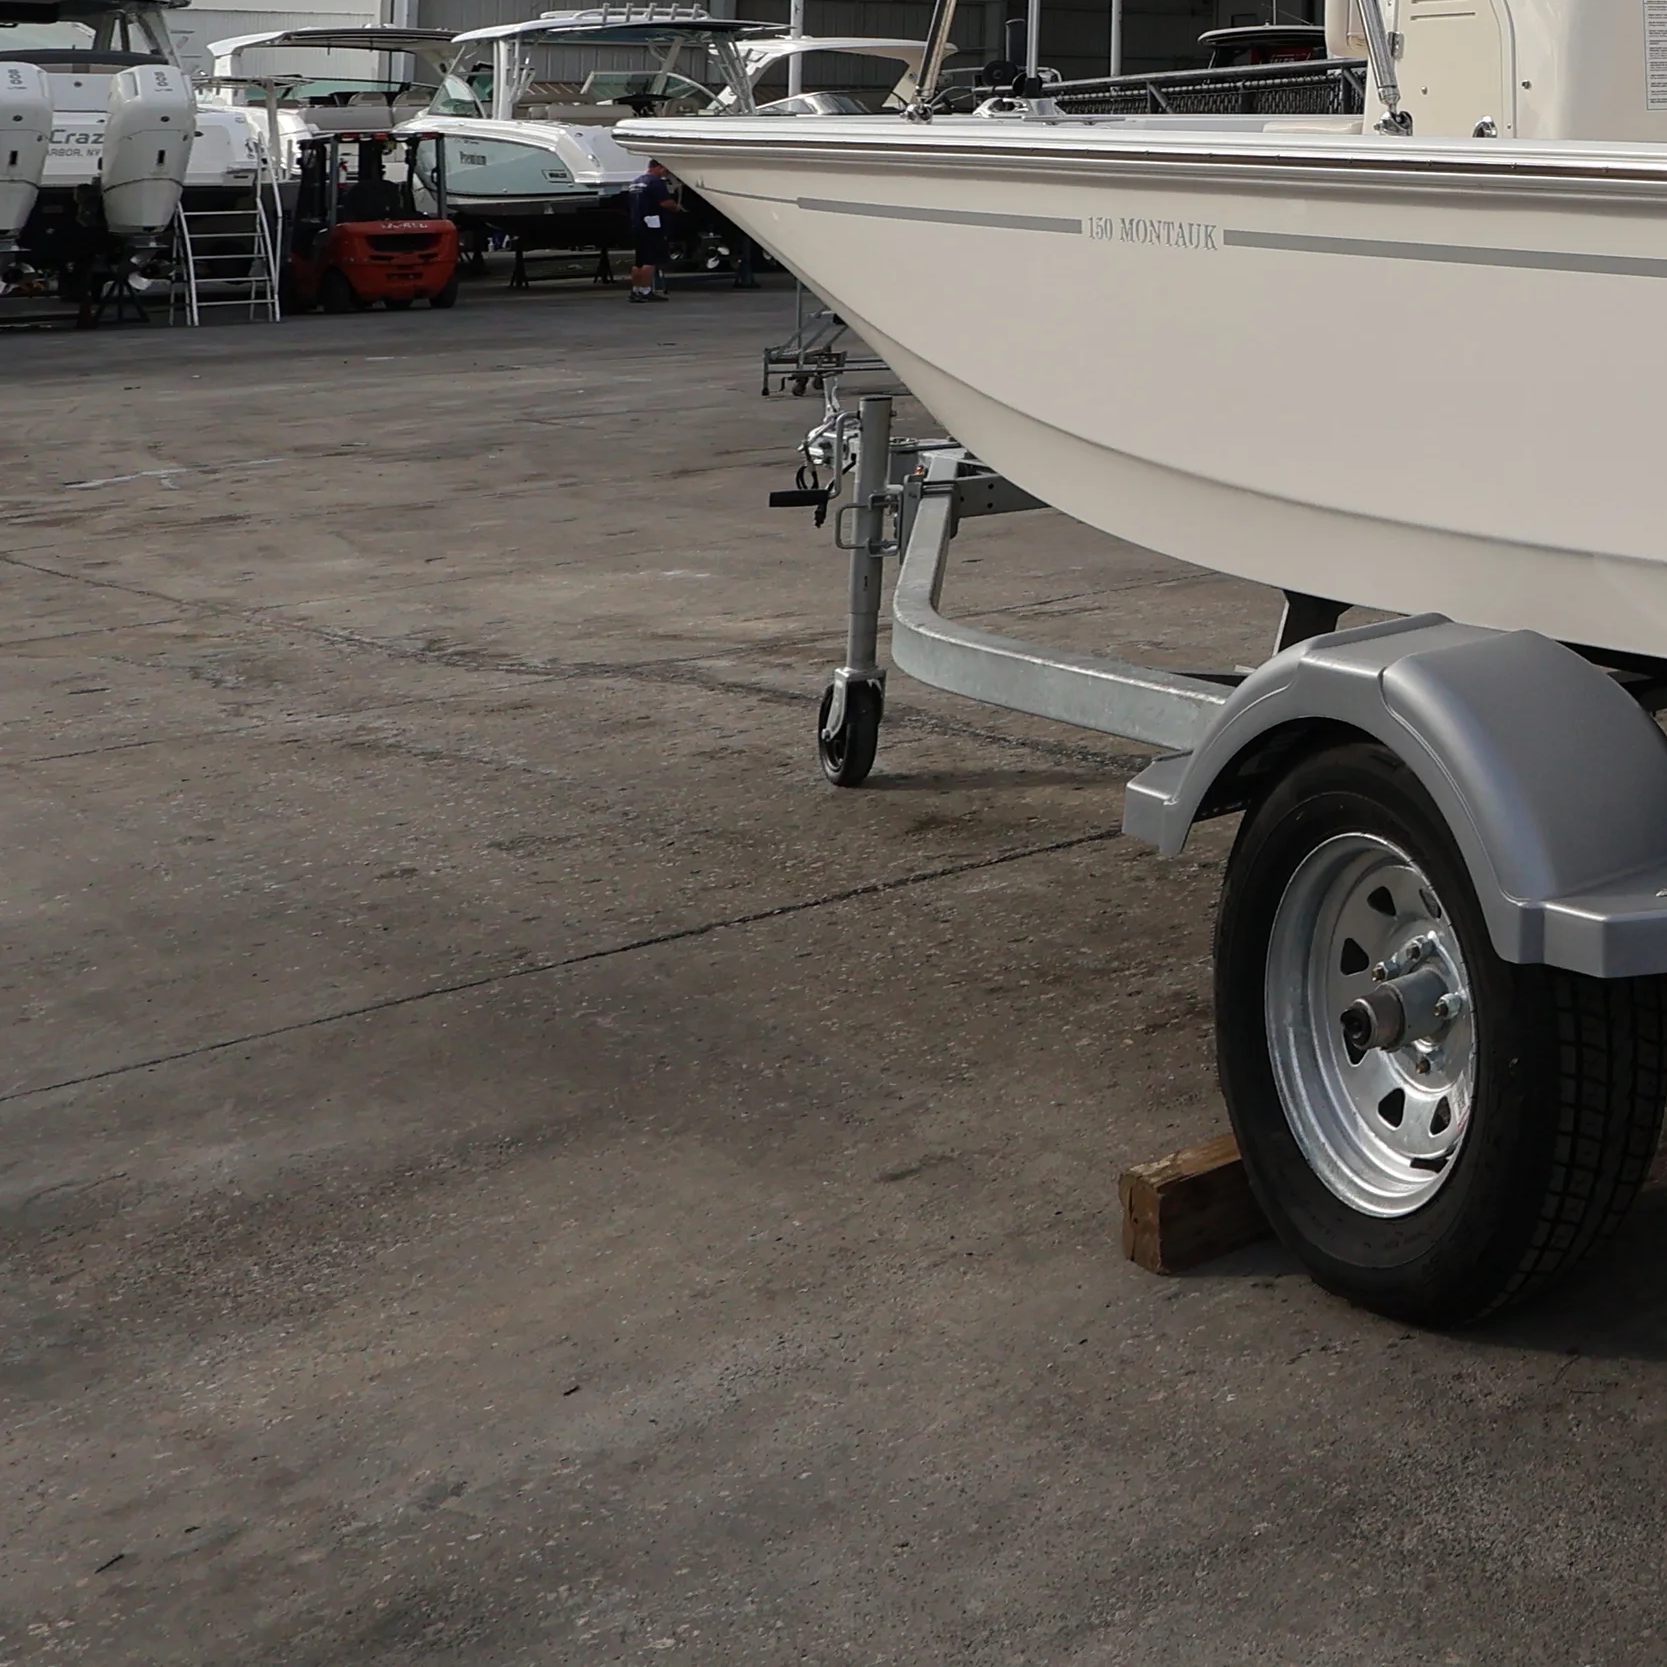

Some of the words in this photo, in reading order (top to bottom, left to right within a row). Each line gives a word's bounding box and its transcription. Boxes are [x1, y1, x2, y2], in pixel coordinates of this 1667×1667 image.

[49, 129, 105, 144] Craz
[1088, 216, 1113, 241] 150
[1119, 217, 1218, 251] MONTAUK
